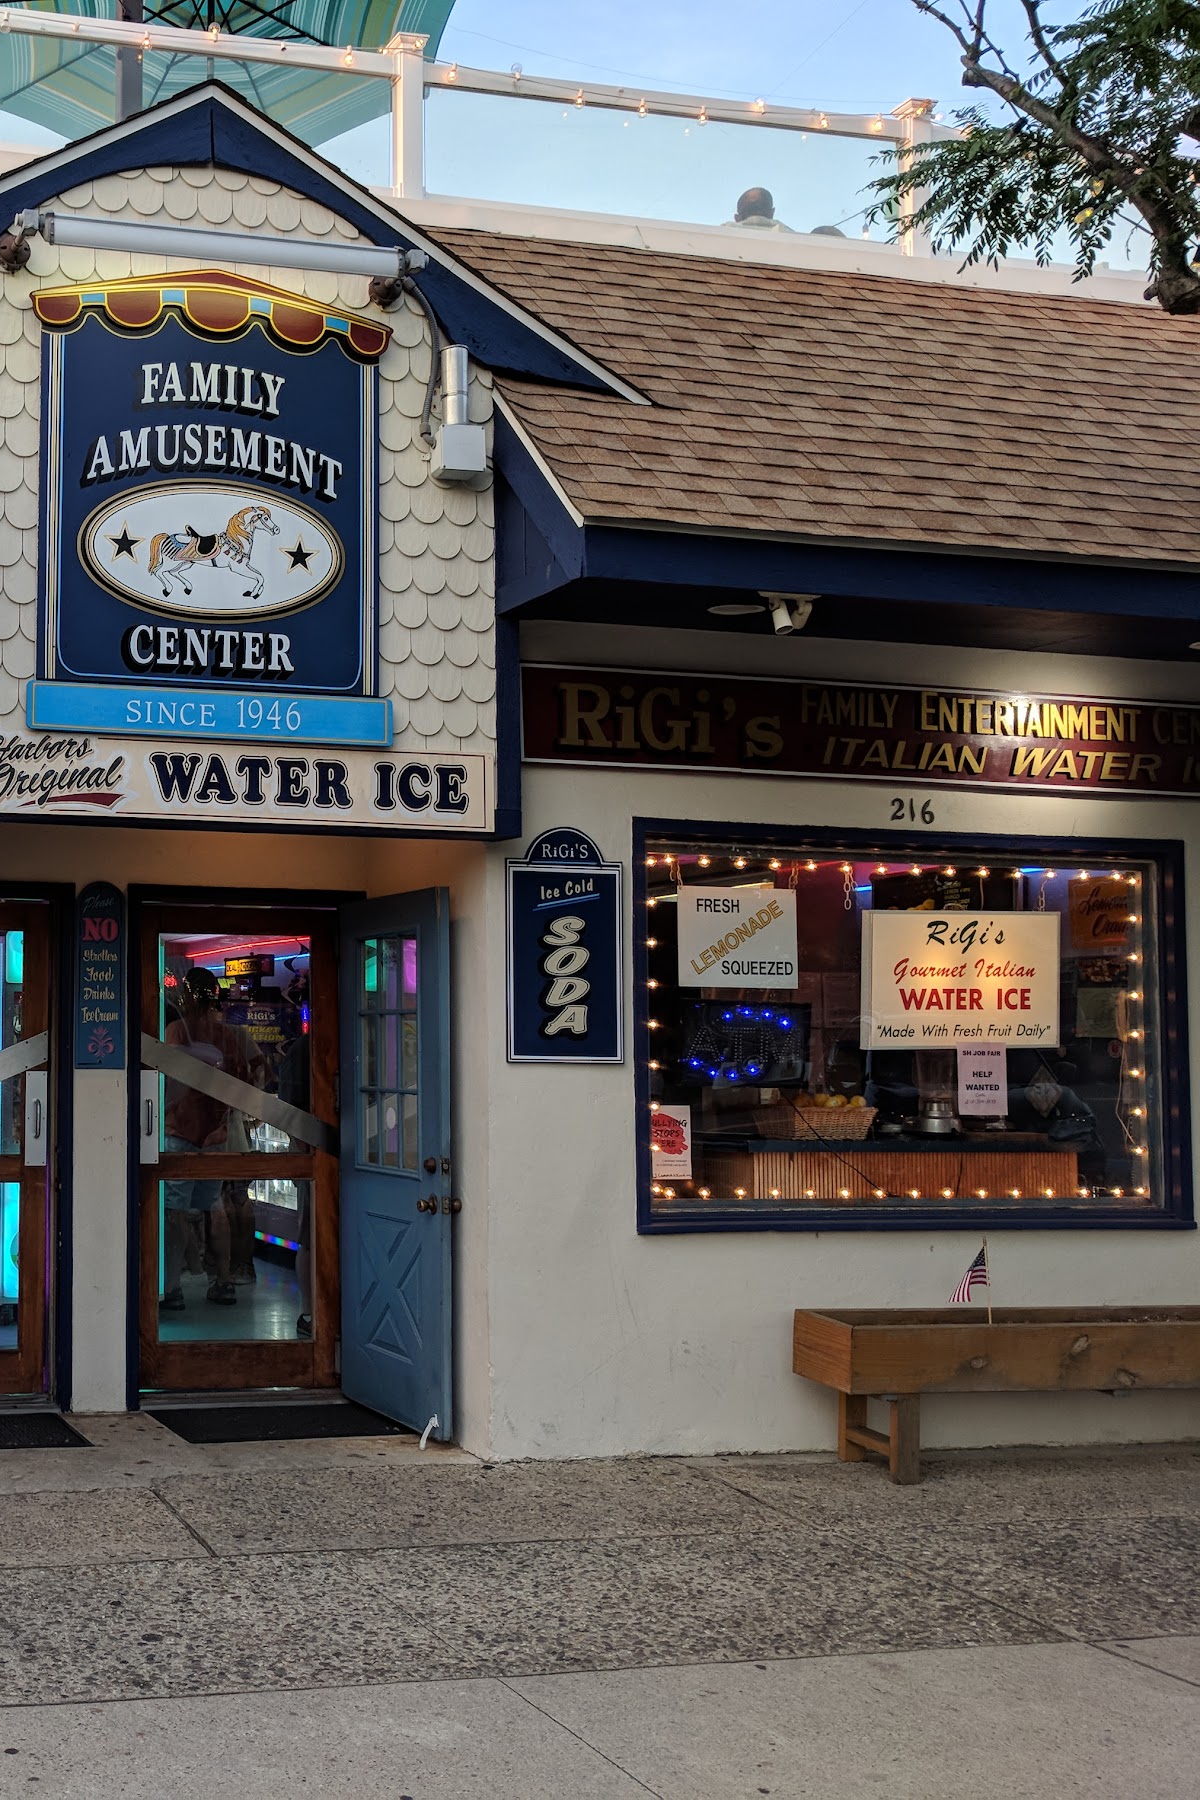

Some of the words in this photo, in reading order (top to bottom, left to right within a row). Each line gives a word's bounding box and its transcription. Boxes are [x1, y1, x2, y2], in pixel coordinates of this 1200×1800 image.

[141, 362, 286, 416] FAMILY
[86, 424, 343, 499] AMUSEMENT
[130, 624, 295, 672] CENTER
[126, 700, 217, 727] SINCE
[237, 699, 301, 731] 1946
[560, 682, 783, 757] RiGi's
[801, 684, 899, 728] FAMILY
[921, 691, 1141, 742] ENTERTAINMENT
[823, 736, 988, 774] ITALIAN
[1012, 747, 1162, 783] WATER
[149, 752, 353, 809] WATER
[374, 761, 470, 813] ICE
[890, 797, 935, 825] 216
[541, 885, 560, 900] Ice
[565, 878, 594, 895] Cold
[696, 898, 740, 913] FRESH
[82, 917, 119, 942] NO
[690, 900, 784, 976] LEMONADE
[926, 920, 1006, 954] RiGi's
[83, 949, 119, 962] Strollers
[721, 960, 794, 976] SQUEEZED
[84, 967, 114, 981] Food
[543, 915, 590, 1035] SODA
[894, 958, 967, 984] Gourmet
[974, 958, 1036, 978] Italian
[83, 985, 115, 1001] Drinks
[899, 988, 984, 1010] WATER
[997, 988, 1031, 1010] ICE
[922, 1024, 948, 1037] With
[953, 1024, 983, 1037] Fresh
[987, 1024, 1012, 1037] Fruit
[965, 1083, 999, 1091] WANTED
[652, 1119, 687, 1127] ULLYING
